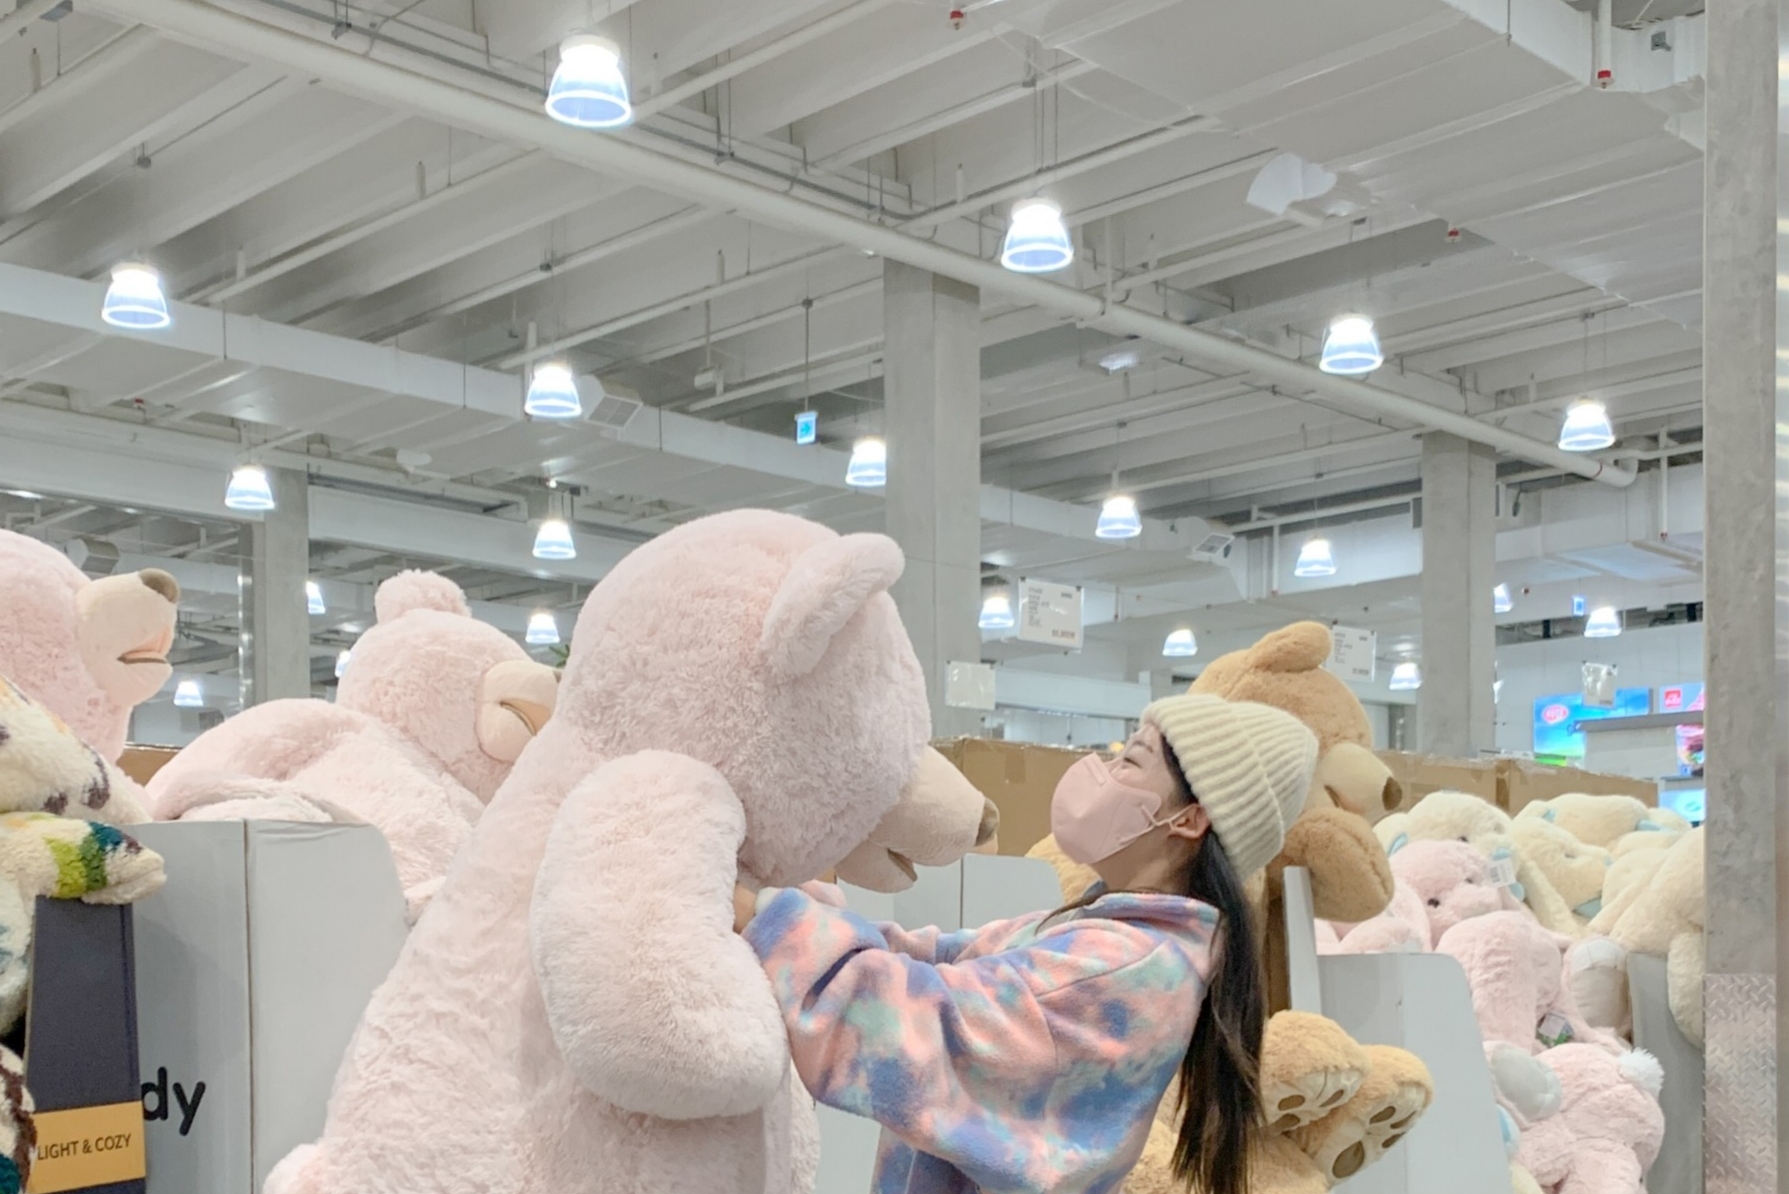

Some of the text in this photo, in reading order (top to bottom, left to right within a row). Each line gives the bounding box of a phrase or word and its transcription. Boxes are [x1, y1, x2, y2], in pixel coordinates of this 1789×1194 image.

[37, 1133, 132, 1161] LIGHT & COZY
